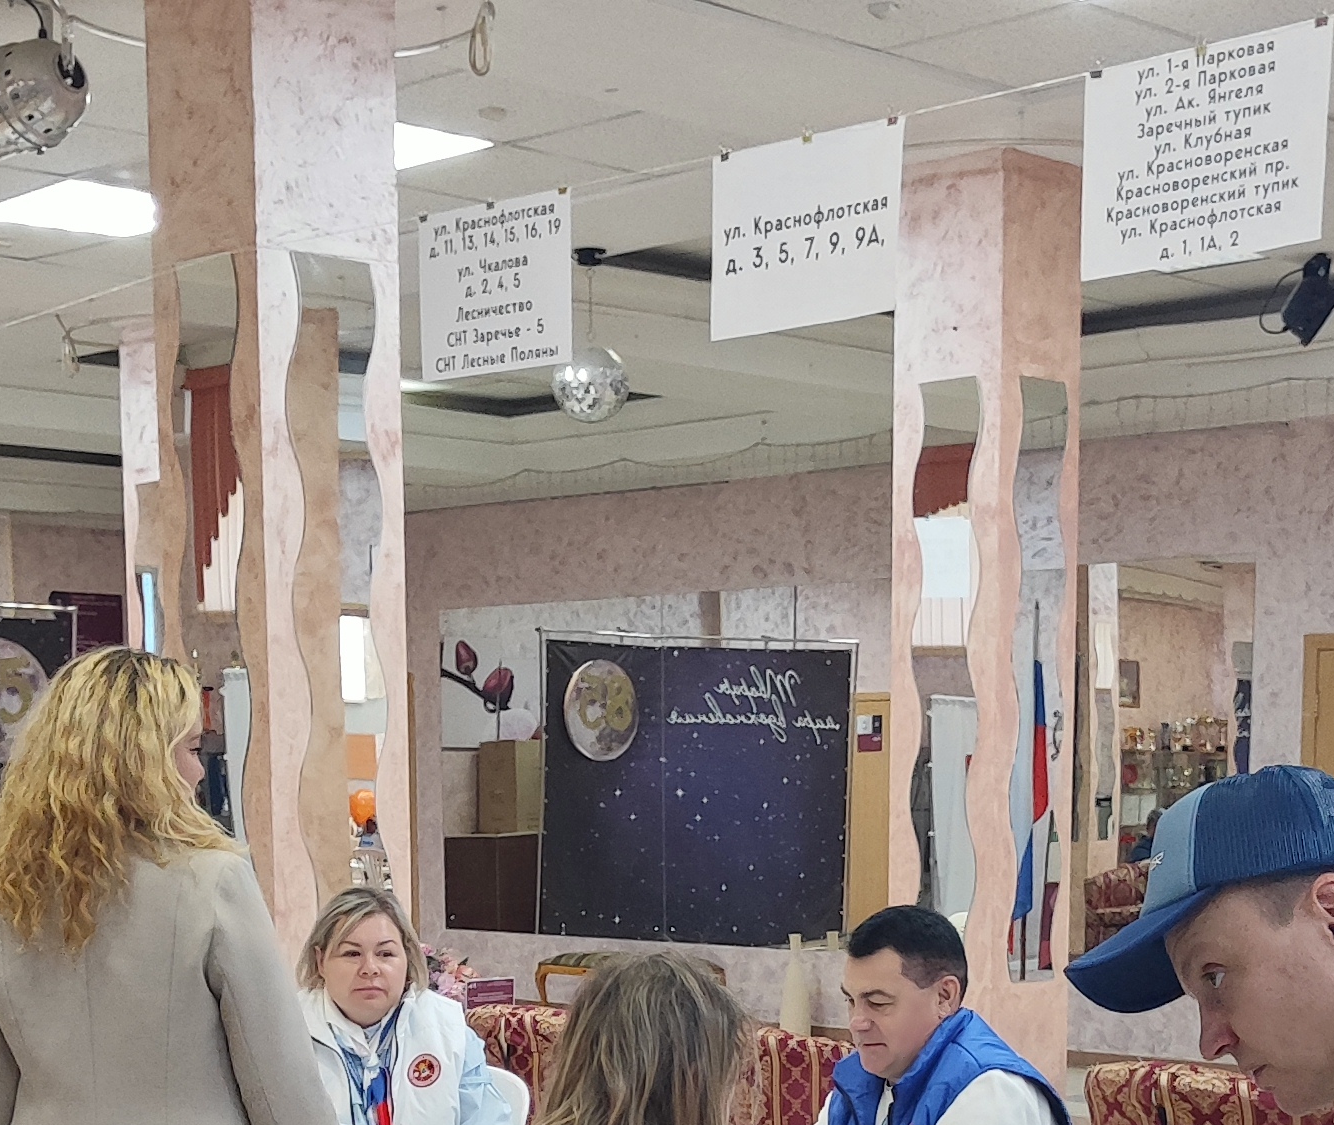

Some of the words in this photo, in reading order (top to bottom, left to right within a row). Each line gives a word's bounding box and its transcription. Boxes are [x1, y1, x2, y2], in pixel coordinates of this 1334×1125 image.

[1137, 69, 1160, 84] ул.
[1167, 58, 1189, 73] 1-я
[1196, 40, 1274, 67] Парковая
[1135, 89, 1157, 105] ул.
[1165, 78, 1190, 94] 2-я
[1198, 60, 1276, 87] Парковая
[1137, 111, 1217, 140] Заречный
[1225, 101, 1271, 124] тупик
[1145, 105, 1167, 123] ул.
[1175, 96, 1200, 112] Ак.
[1208, 83, 1263, 105] Янгеля
[1118, 170, 1139, 187] ул.
[1147, 139, 1289, 179] Красноворенская
[1154, 143, 1176, 162] ул.
[1184, 126, 1252, 150] Клубная
[1106, 185, 1246, 225] Красноворенский
[1254, 177, 1299, 199] тупик
[1116, 163, 1257, 204] Красноворенский
[1265, 161, 1290, 175] пр.
[429, 247, 439, 258] д.
[444, 240, 457, 255] 11,
[462, 235, 478, 251] 13,
[484, 232, 499, 248] 14,
[505, 227, 519, 242] 15,
[524, 222, 542, 239] 16,
[548, 218, 561, 234] 19
[434, 227, 450, 242] ул.
[455, 203, 555, 234] Краснофлотская
[724, 225, 746, 246] ул.
[754, 196, 888, 239] Краснофлотская
[1121, 226, 1142, 244] ул.
[1150, 201, 1281, 238] Краснофлотская
[726, 259, 743, 275] д.
[753, 246, 769, 269] 3,
[779, 242, 794, 265] 5,
[804, 237, 819, 260] 7,
[830, 232, 845, 255] 9,
[855, 224, 885, 249] 9А,
[1160, 248, 1174, 260] д.
[1183, 240, 1191, 256] 1,
[1230, 231, 1239, 247] 2
[457, 267, 474, 282] ул.
[479, 255, 528, 274] Чкалова
[465, 286, 476, 298] д.
[481, 278, 492, 294] 2,
[497, 276, 507, 292] 4,
[513, 273, 521, 288] 5
[456, 301, 533, 322] Лесничество
[447, 331, 468, 347] СНТ
[473, 327, 520, 345] Заречье
[537, 318, 544, 333] 5
[436, 356, 456, 372] СНТ
[461, 354, 505, 369] Лесные
[511, 346, 558, 362] Поляны
